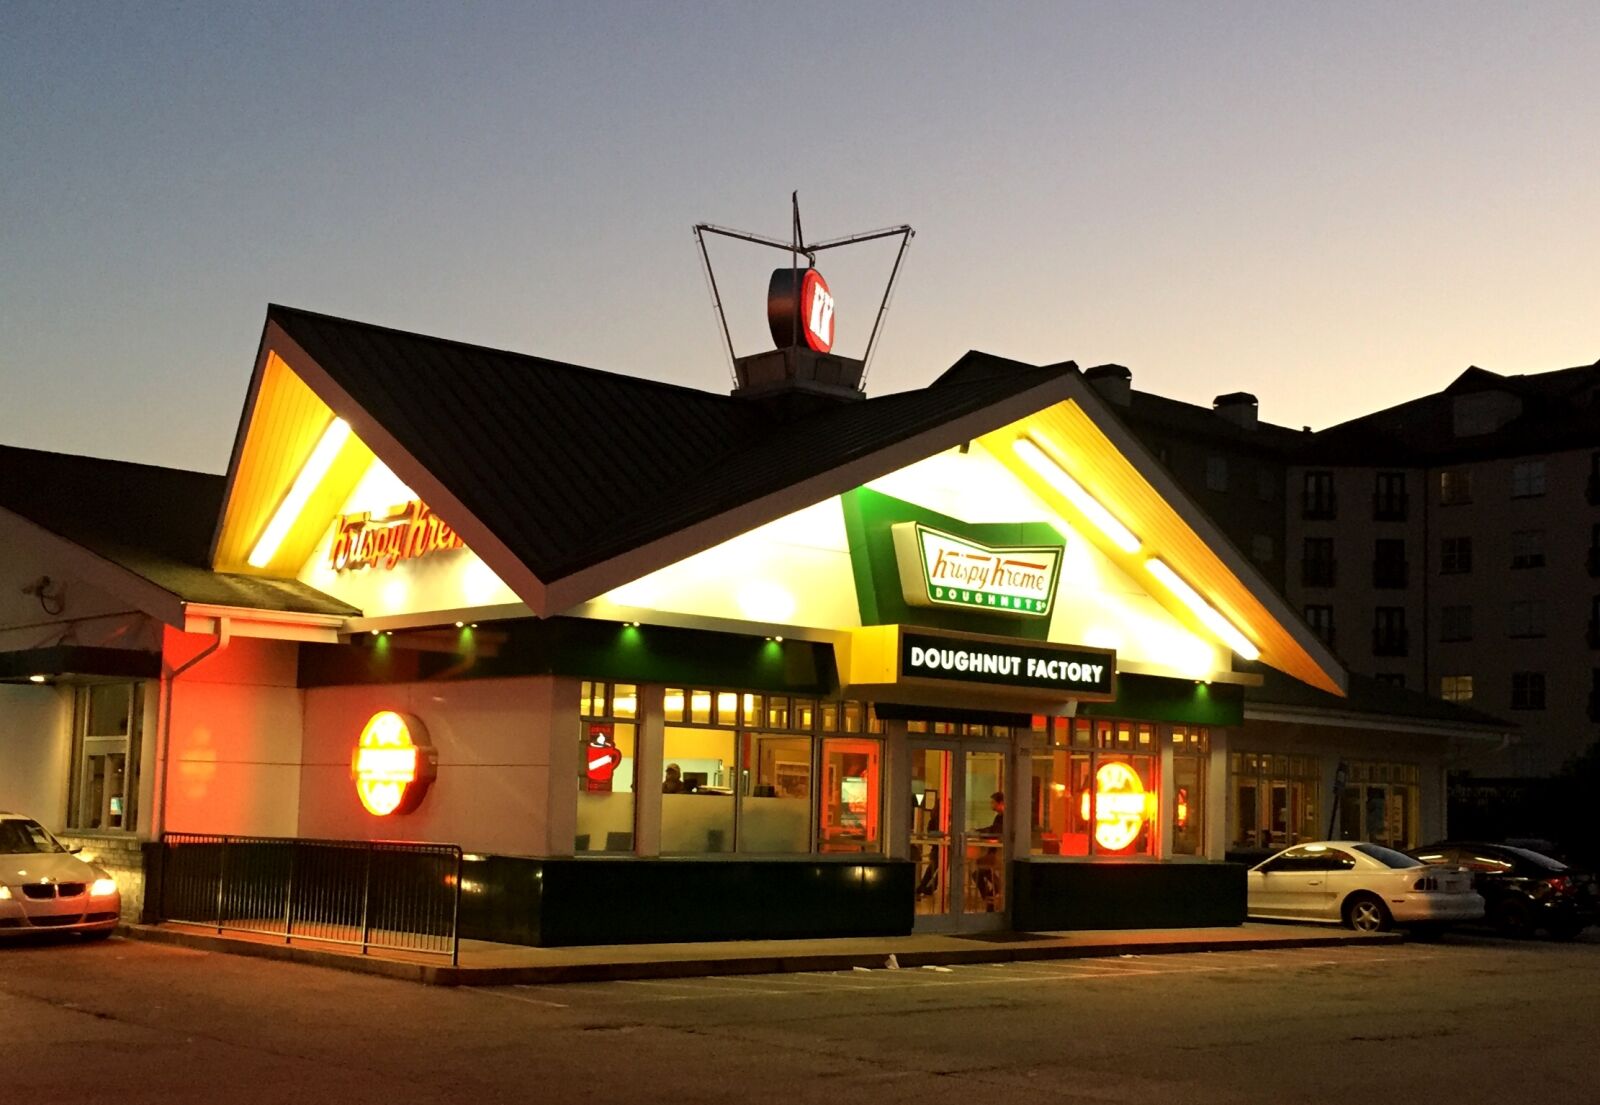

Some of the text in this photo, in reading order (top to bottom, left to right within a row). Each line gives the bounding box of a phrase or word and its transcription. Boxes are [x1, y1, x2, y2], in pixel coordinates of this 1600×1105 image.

[932, 548, 1048, 591] Krispy Kreme
[935, 587, 1044, 612] DOUGHNUTS
[911, 646, 1103, 683] DOUGHNUT FACTORY
